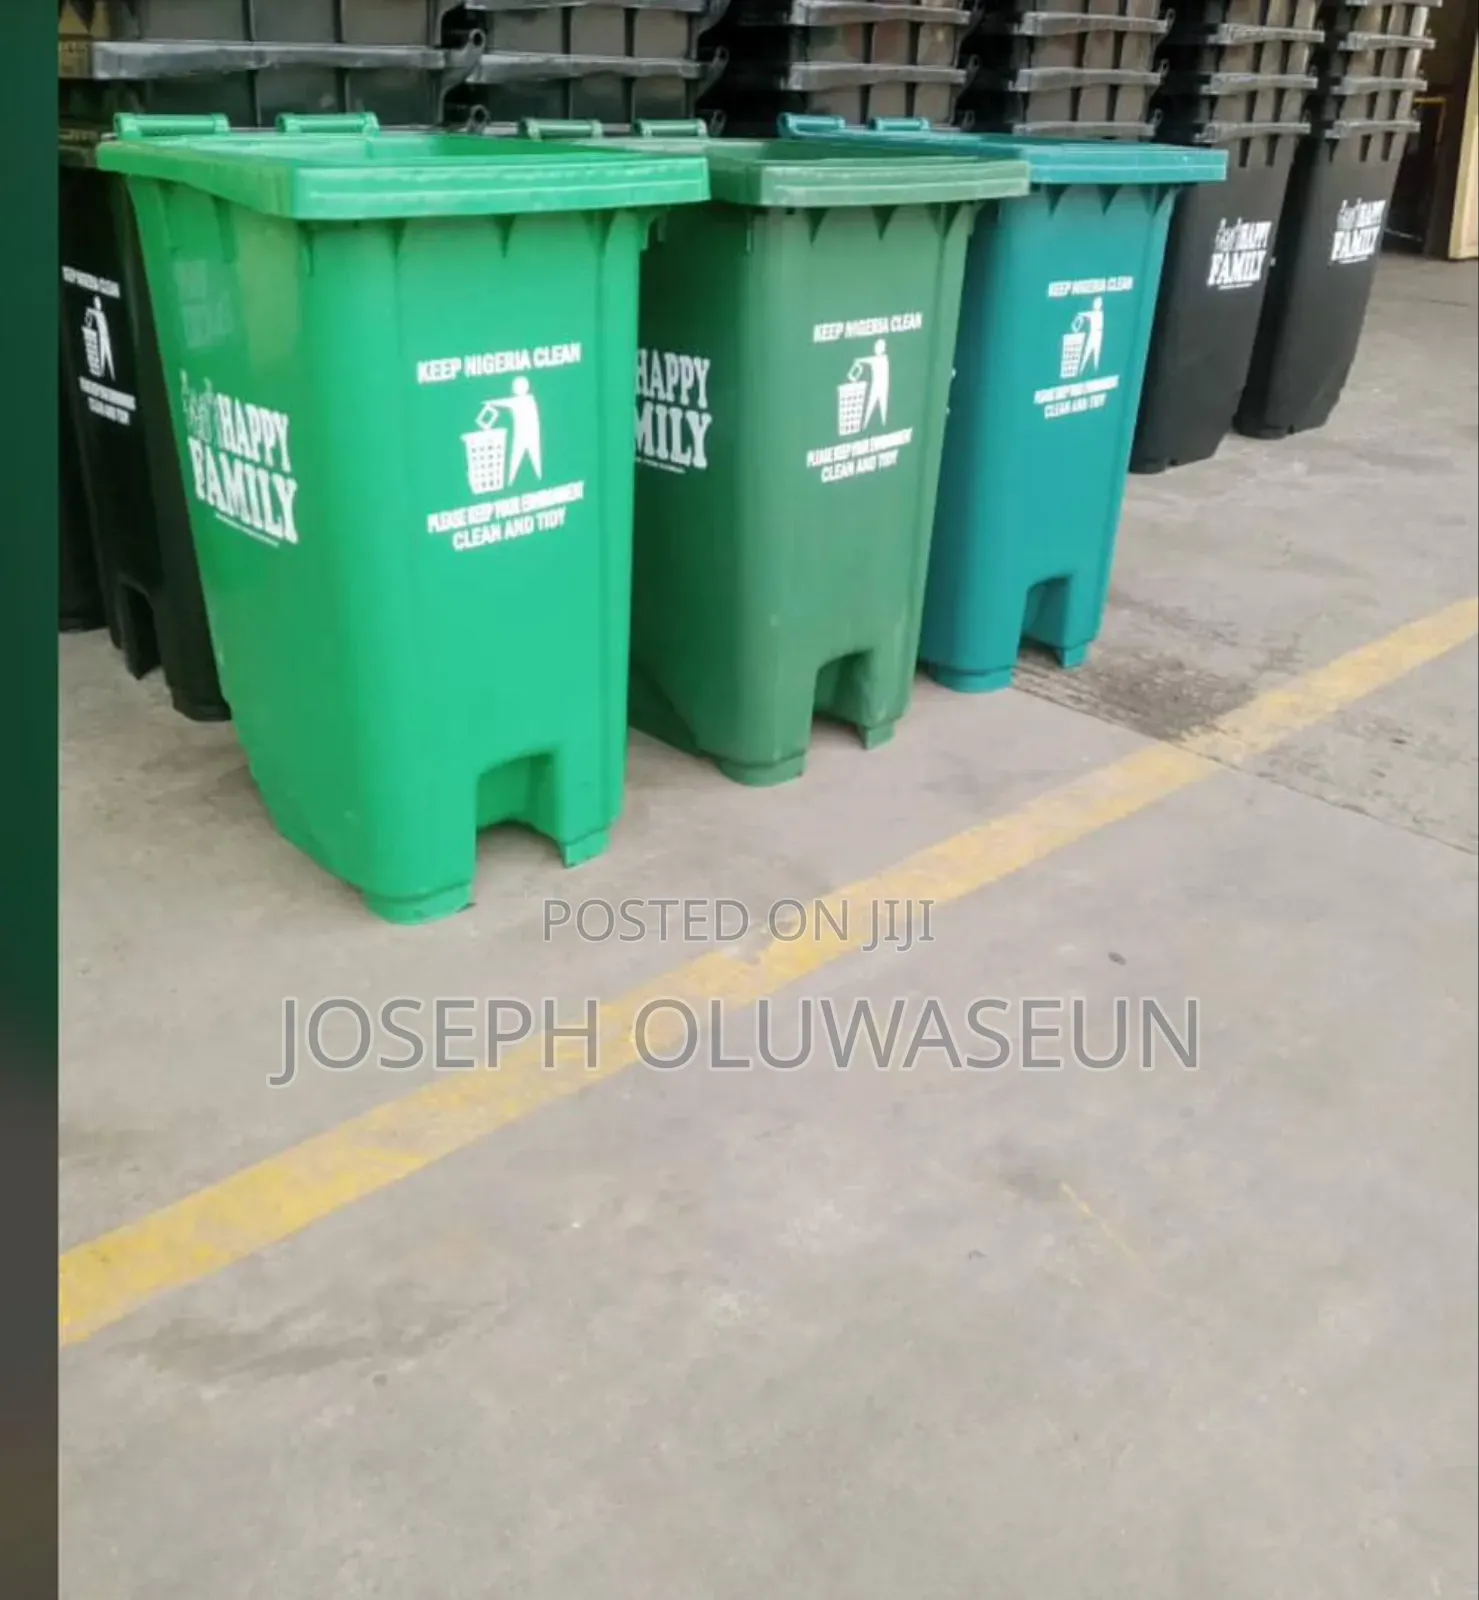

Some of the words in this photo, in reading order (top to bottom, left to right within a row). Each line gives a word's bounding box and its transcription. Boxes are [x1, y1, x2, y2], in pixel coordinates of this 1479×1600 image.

[1331, 226, 1381, 261] FAMILY
[1207, 250, 1267, 286] FAMILY
[813, 322, 844, 343] KEEP
[890, 311, 922, 333] CLEAN
[417, 357, 461, 385] KEEP
[463, 348, 531, 378] NIGERIA
[533, 341, 582, 368] CLEAN
[635, 348, 711, 410] HAPPY
[216, 391, 291, 474] HAPPY
[634, 400, 712, 470] MILY
[187, 435, 298, 544] FAMILY
[821, 460, 854, 484] CLEAN
[452, 521, 501, 551] CLEAN
[504, 513, 534, 540] AND
[535, 505, 566, 531] TIDY
